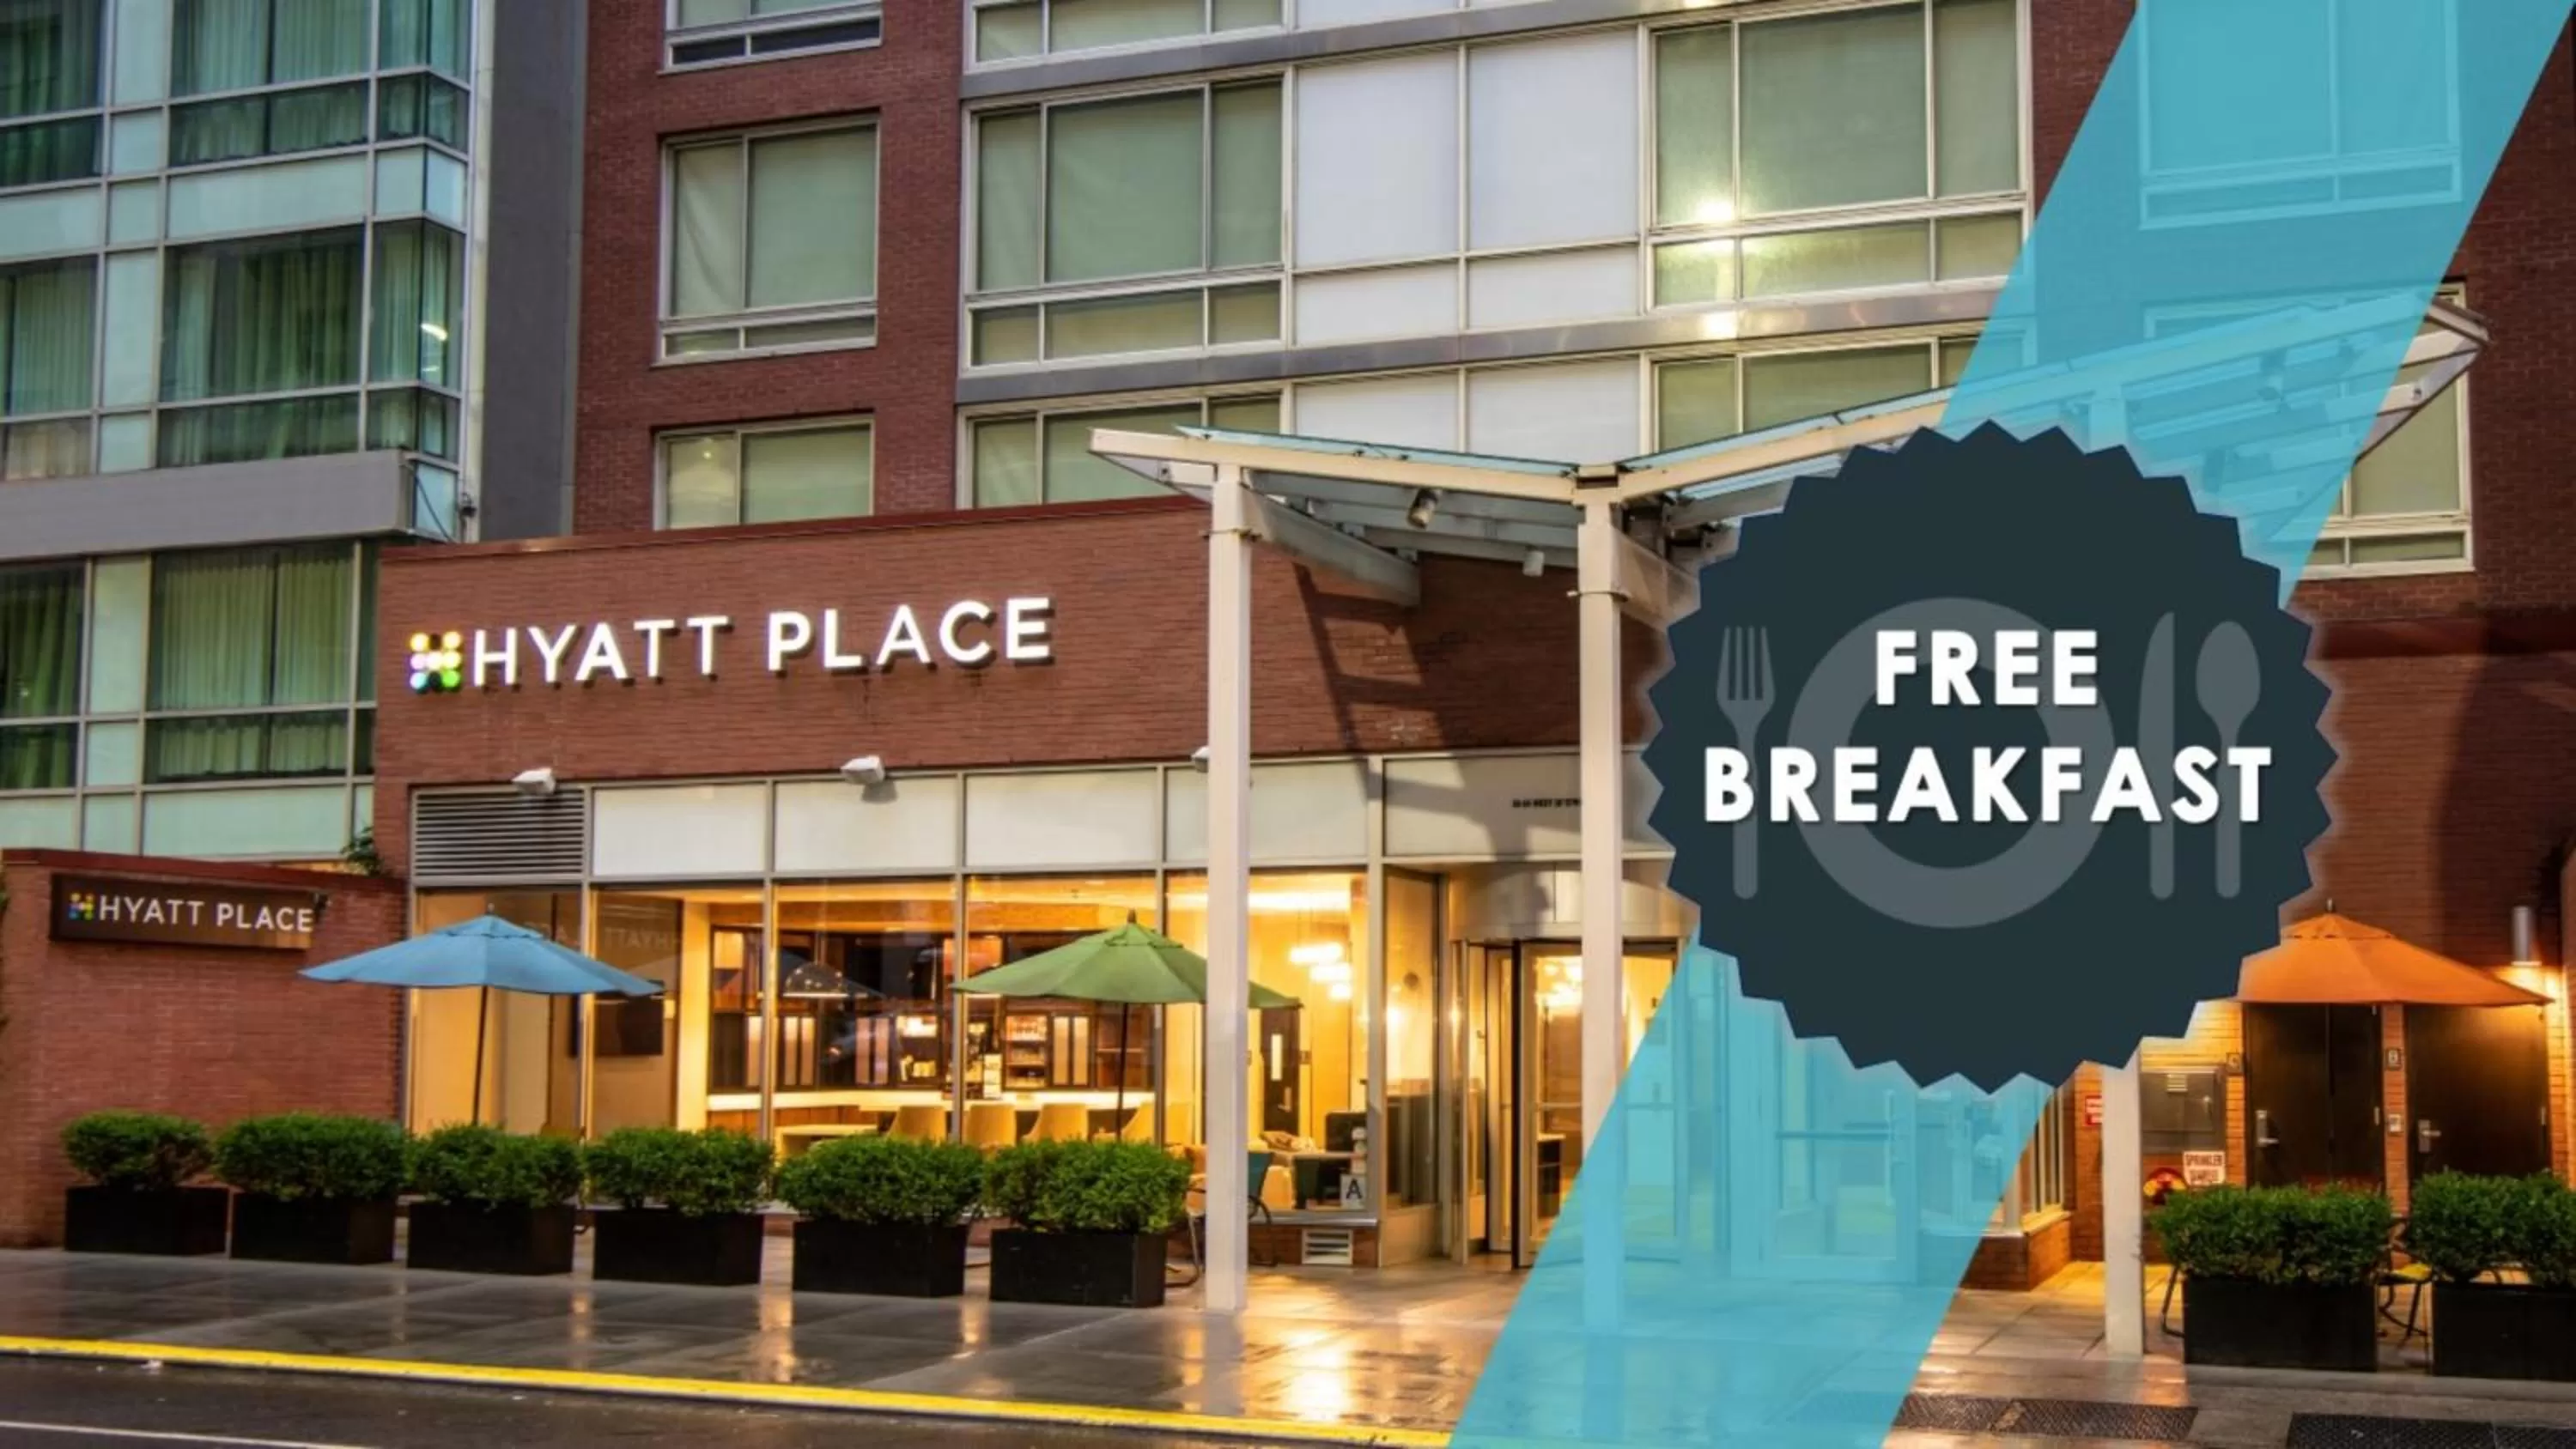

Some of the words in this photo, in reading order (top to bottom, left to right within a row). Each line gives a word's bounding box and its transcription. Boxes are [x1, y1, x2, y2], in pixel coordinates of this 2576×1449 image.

[473, 615, 730, 686] HYATT
[768, 597, 1052, 672] PLACE
[99, 894, 205, 925] HYATT
[216, 902, 314, 932] PLACE
[1346, 1178, 1363, 1200] A
